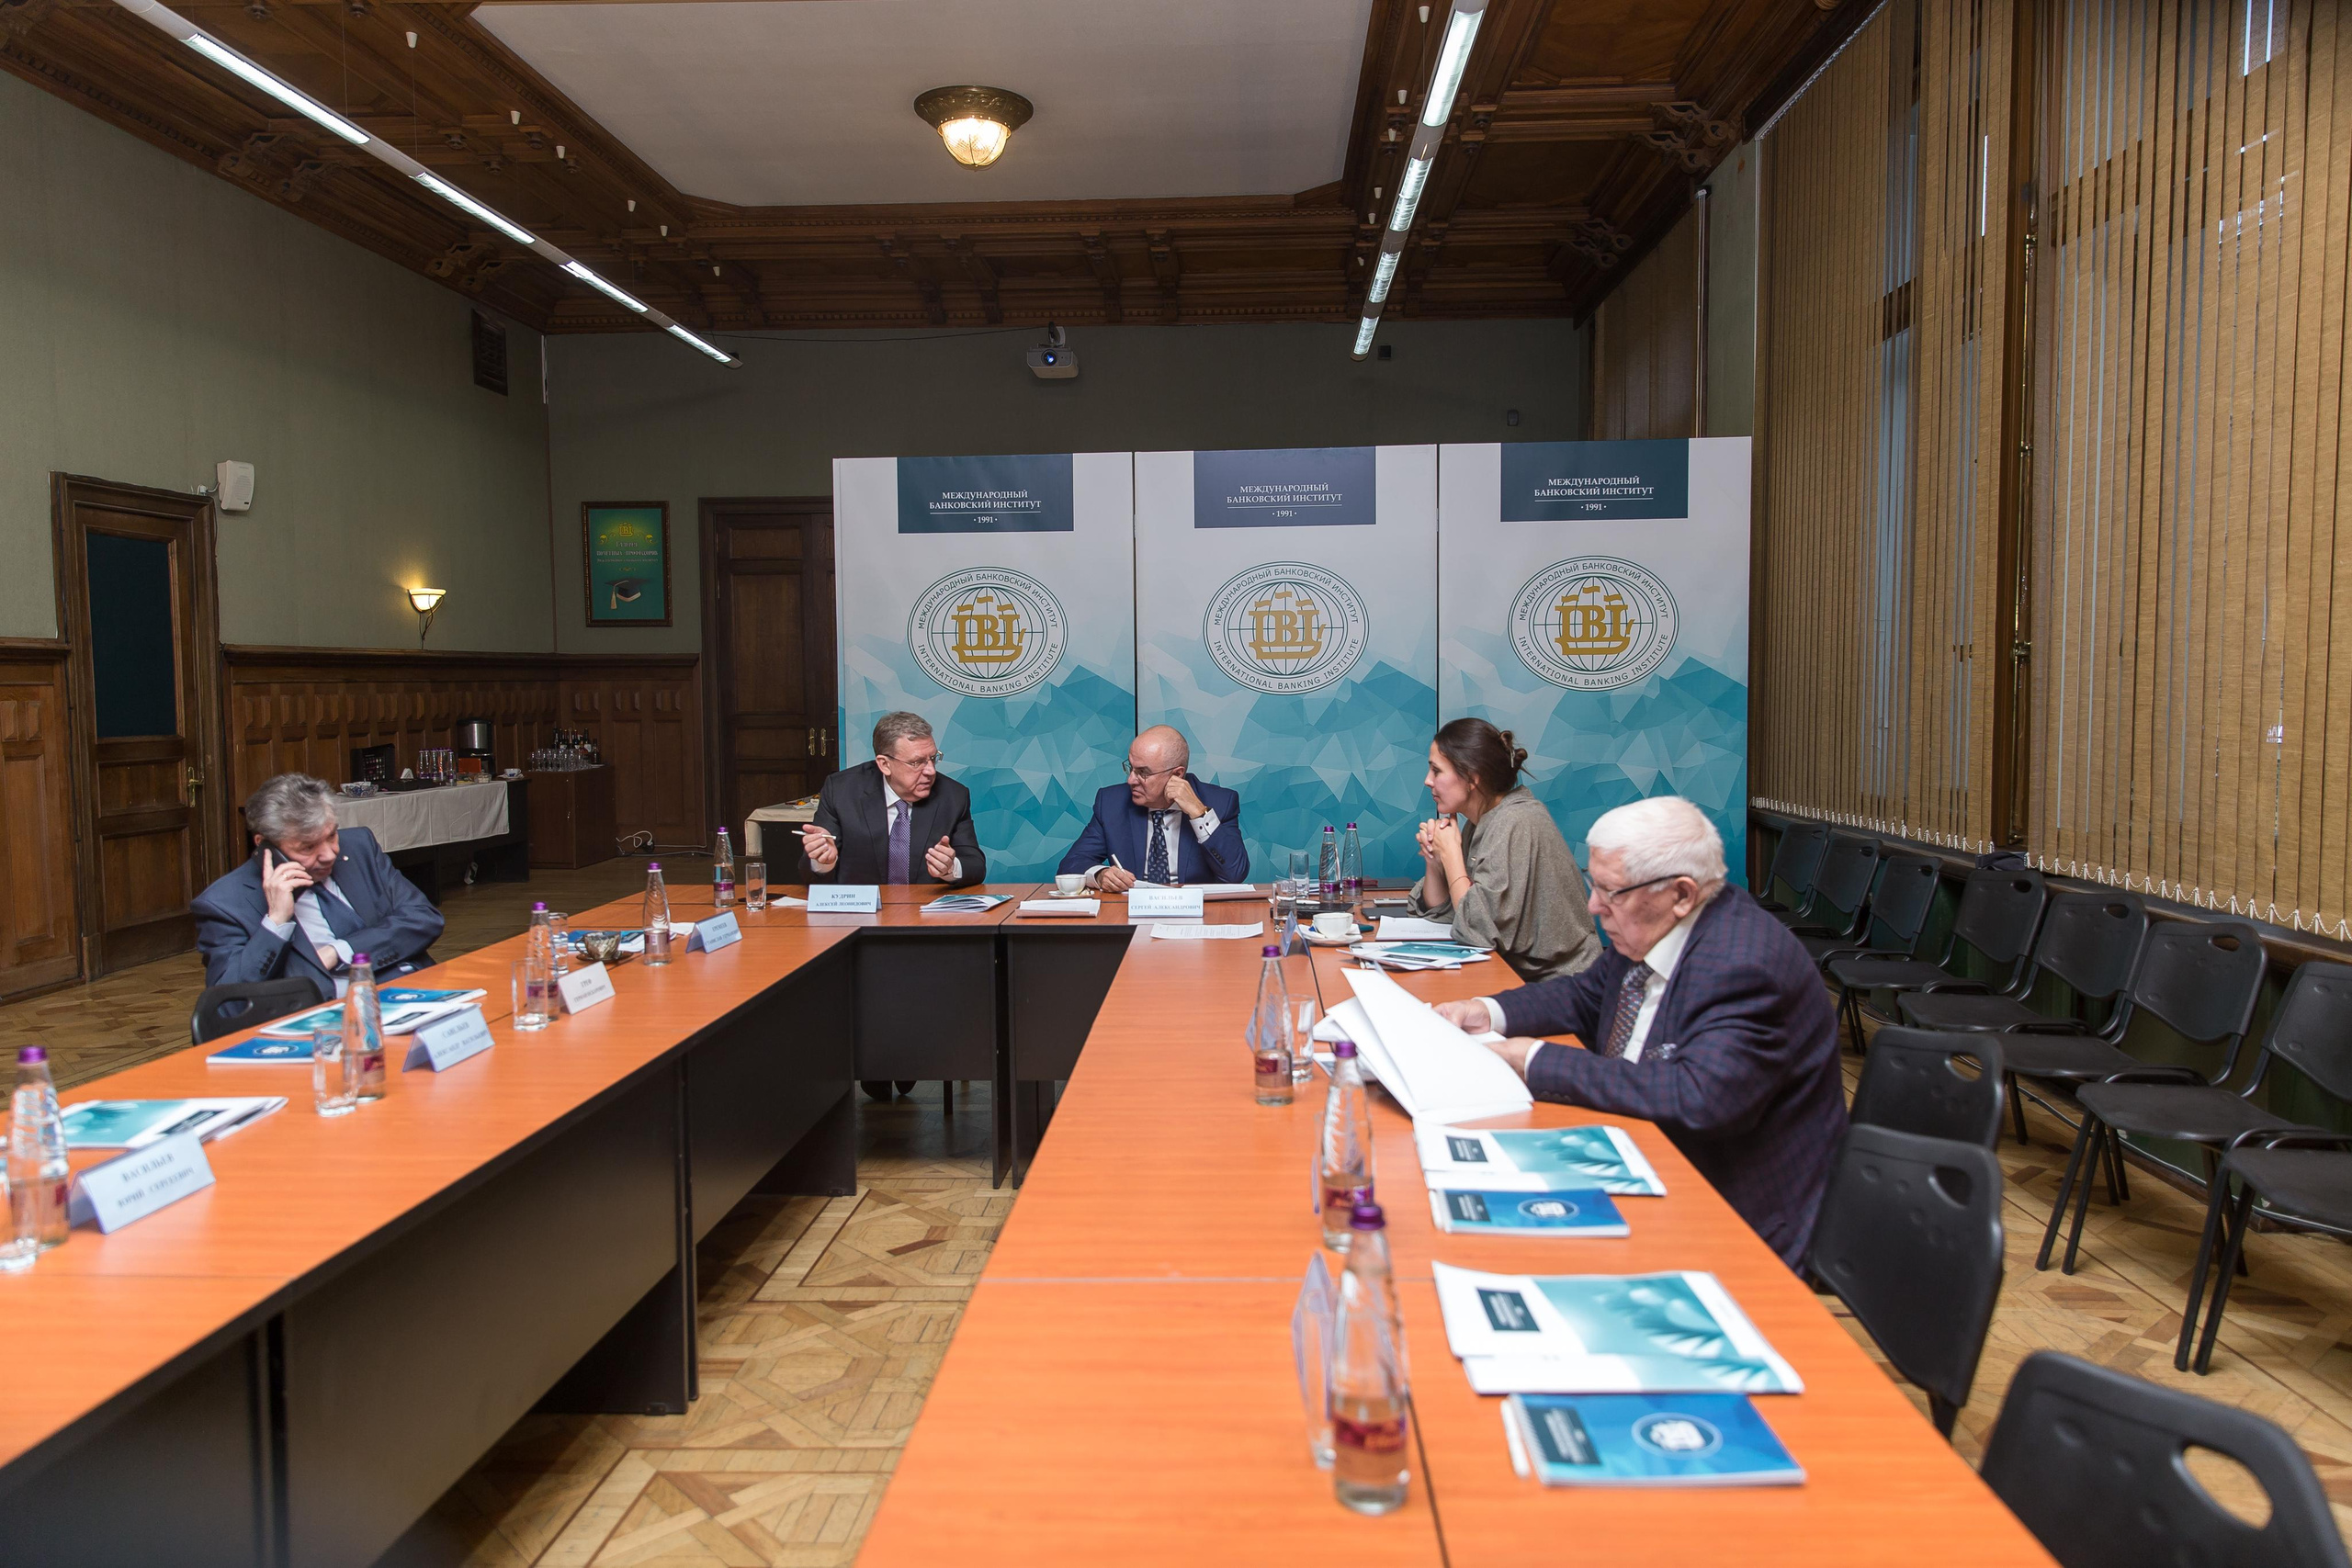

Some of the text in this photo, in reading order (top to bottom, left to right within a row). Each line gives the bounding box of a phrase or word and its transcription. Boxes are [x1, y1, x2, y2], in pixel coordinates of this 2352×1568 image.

[1548, 475, 1640, 487] МЕЖДУНАРОДНЫЙ
[1240, 482, 1329, 494] МЕЖДУНАРОДНЫЙ
[1534, 487, 1654, 497] БАНКОВСКИЙ ИНСТИТУТ
[942, 489, 1028, 500] МЕЖДУНАРОДНЫЙ
[1227, 493, 1343, 503] БАНКОВСКИЙ ИНСТИТУТ
[929, 500, 1042, 510] БАНКОВСКИЙ ИНСТИТУТ
[1276, 510, 1293, 518] 1991
[1215, 568, 1359, 626] МЕЖДУНАРОДНЫЙ БАНКОВСКИЙ ИНСТИТУТ
[1520, 562, 1668, 621] МЕЖДУНАРОДНЫЙ БАНКОВСКИЙ ИНСТИТУТ
[918, 573, 1058, 629] МЕЖДУНАРОДНЫЙ БАНКОВСКИЙ ИНСТИТУТ
[1214, 637, 1360, 690] INTERNATIONAL BANKING INSTITUTE
[1518, 634, 1668, 686] INTERNATIONAL BANKING INSTITUTE
[918, 643, 1058, 693] INTERNATIONAL BANKING INSTITUTE
